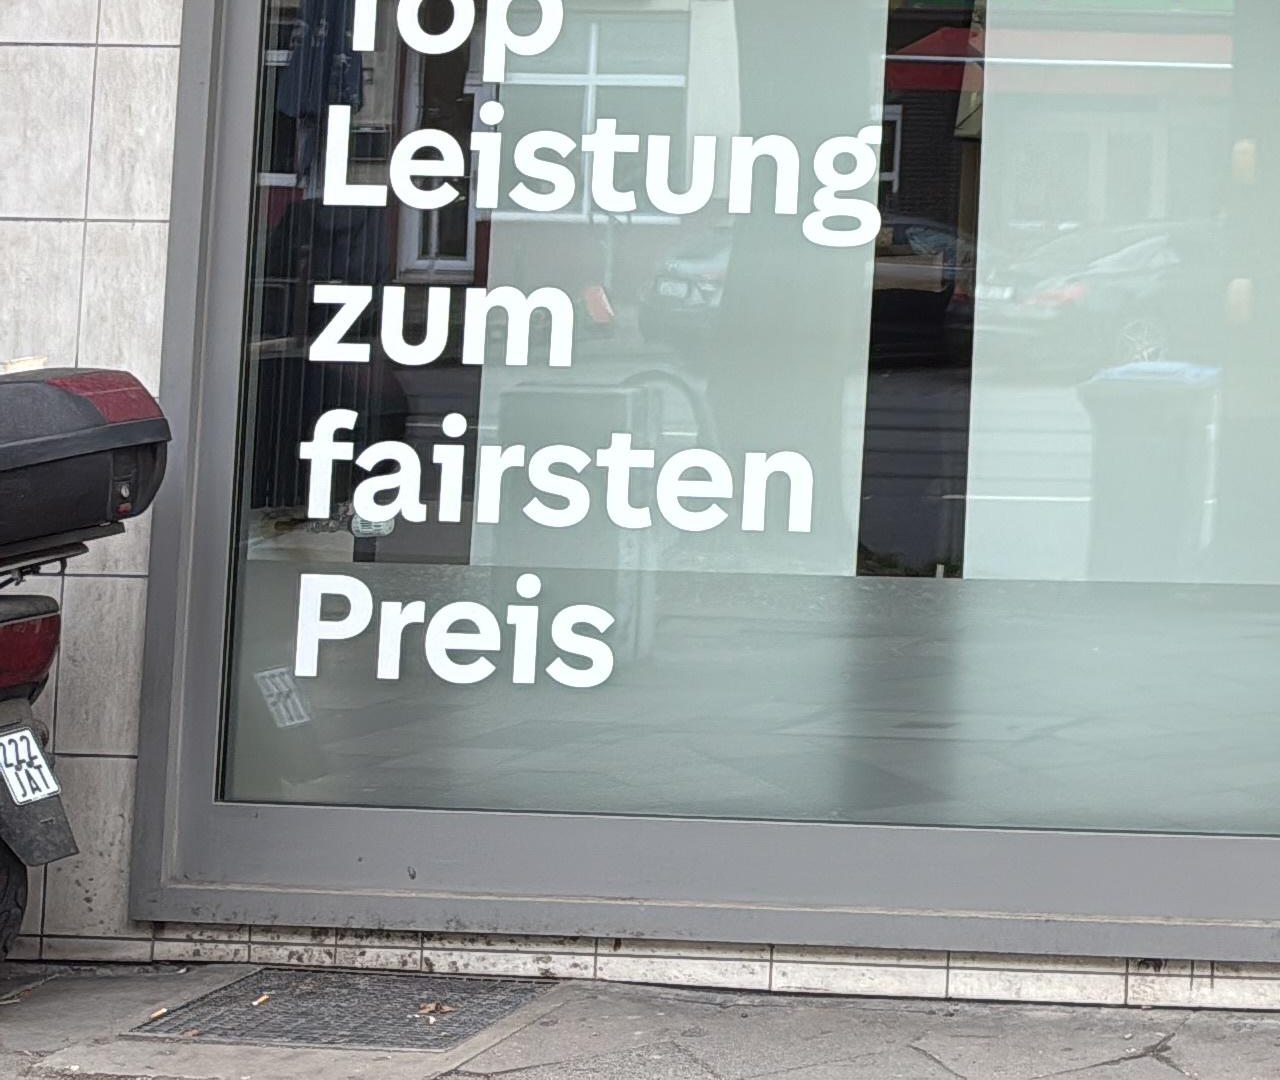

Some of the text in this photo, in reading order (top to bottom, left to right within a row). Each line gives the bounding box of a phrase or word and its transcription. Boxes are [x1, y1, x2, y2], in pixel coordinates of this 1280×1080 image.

[322, 100, 883, 247] Leistung
[308, 284, 575, 368] zum
[299, 408, 814, 533] fairsten
[294, 574, 615, 688] Preis
[15, 764, 50, 798] JAT
